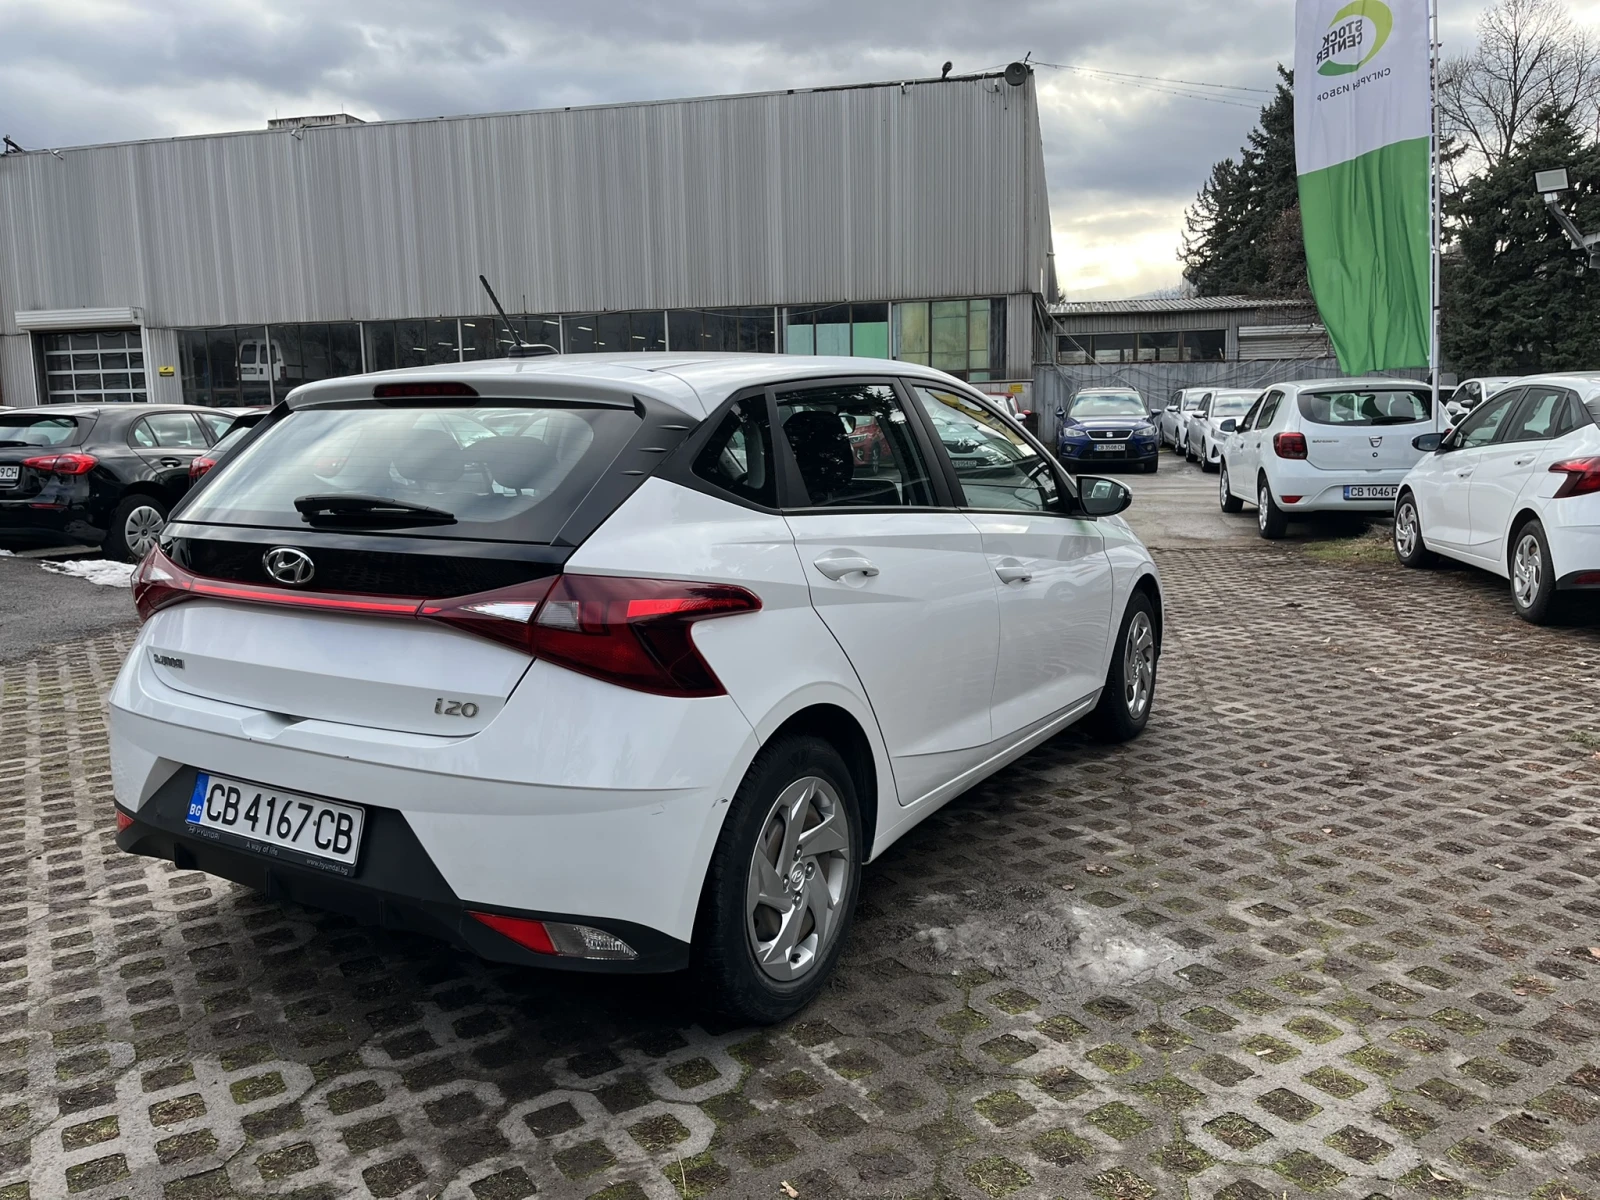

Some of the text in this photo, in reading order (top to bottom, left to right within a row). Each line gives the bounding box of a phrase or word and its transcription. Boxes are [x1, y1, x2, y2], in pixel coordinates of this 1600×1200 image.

[1350, 487, 1364, 497] CB
[1366, 487, 1390, 497] 1046
[189, 803, 202, 817] BG
[206, 783, 354, 855] CB 4167 CB
